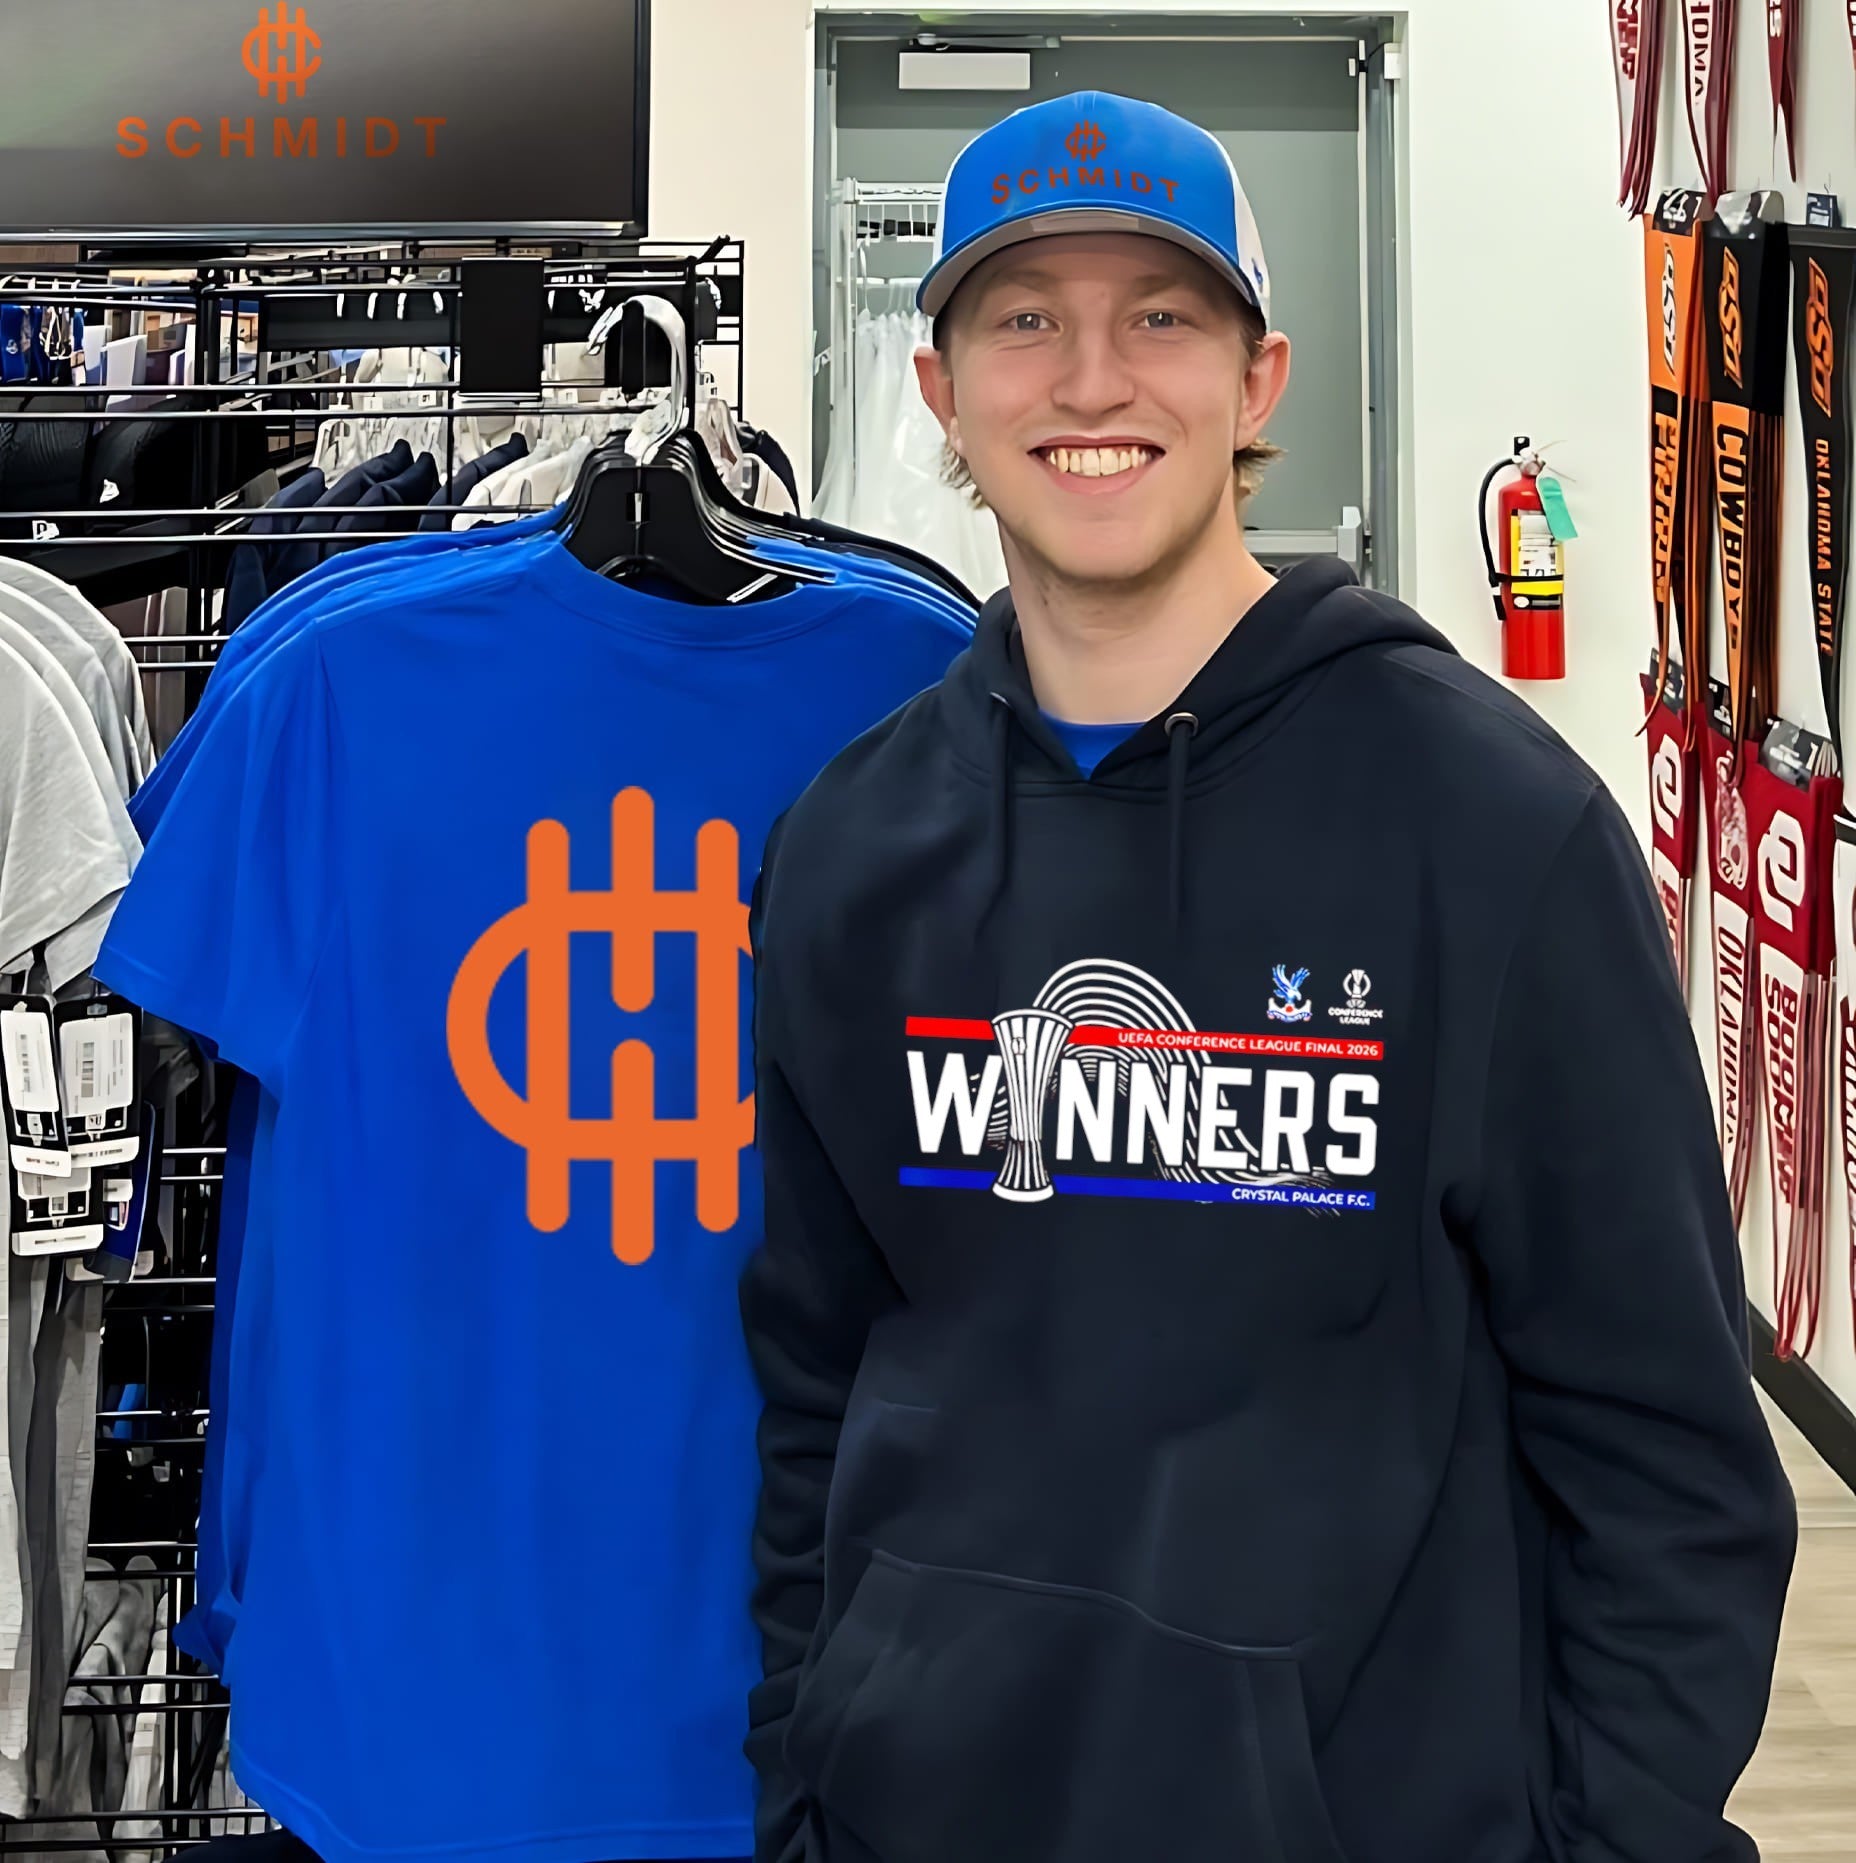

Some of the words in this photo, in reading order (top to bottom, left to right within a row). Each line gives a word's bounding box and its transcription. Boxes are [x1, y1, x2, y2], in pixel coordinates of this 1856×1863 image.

[115, 116, 448, 159] SCHMIDT
[991, 167, 1179, 204] SCHMIDT
[1815, 438, 1832, 570] OKLAHOMA
[1118, 1032, 1153, 1045] UEFA
[1156, 1033, 1246, 1049] CONFERENCE
[1249, 1039, 1302, 1052] LEAGUE
[1305, 1042, 1343, 1054] FINAL
[1347, 1044, 1379, 1056] 2026
[1231, 1188, 1289, 1202] CRYSTAL
[1292, 1191, 1343, 1205] PALACE
[1347, 1194, 1371, 1206] F.C.
